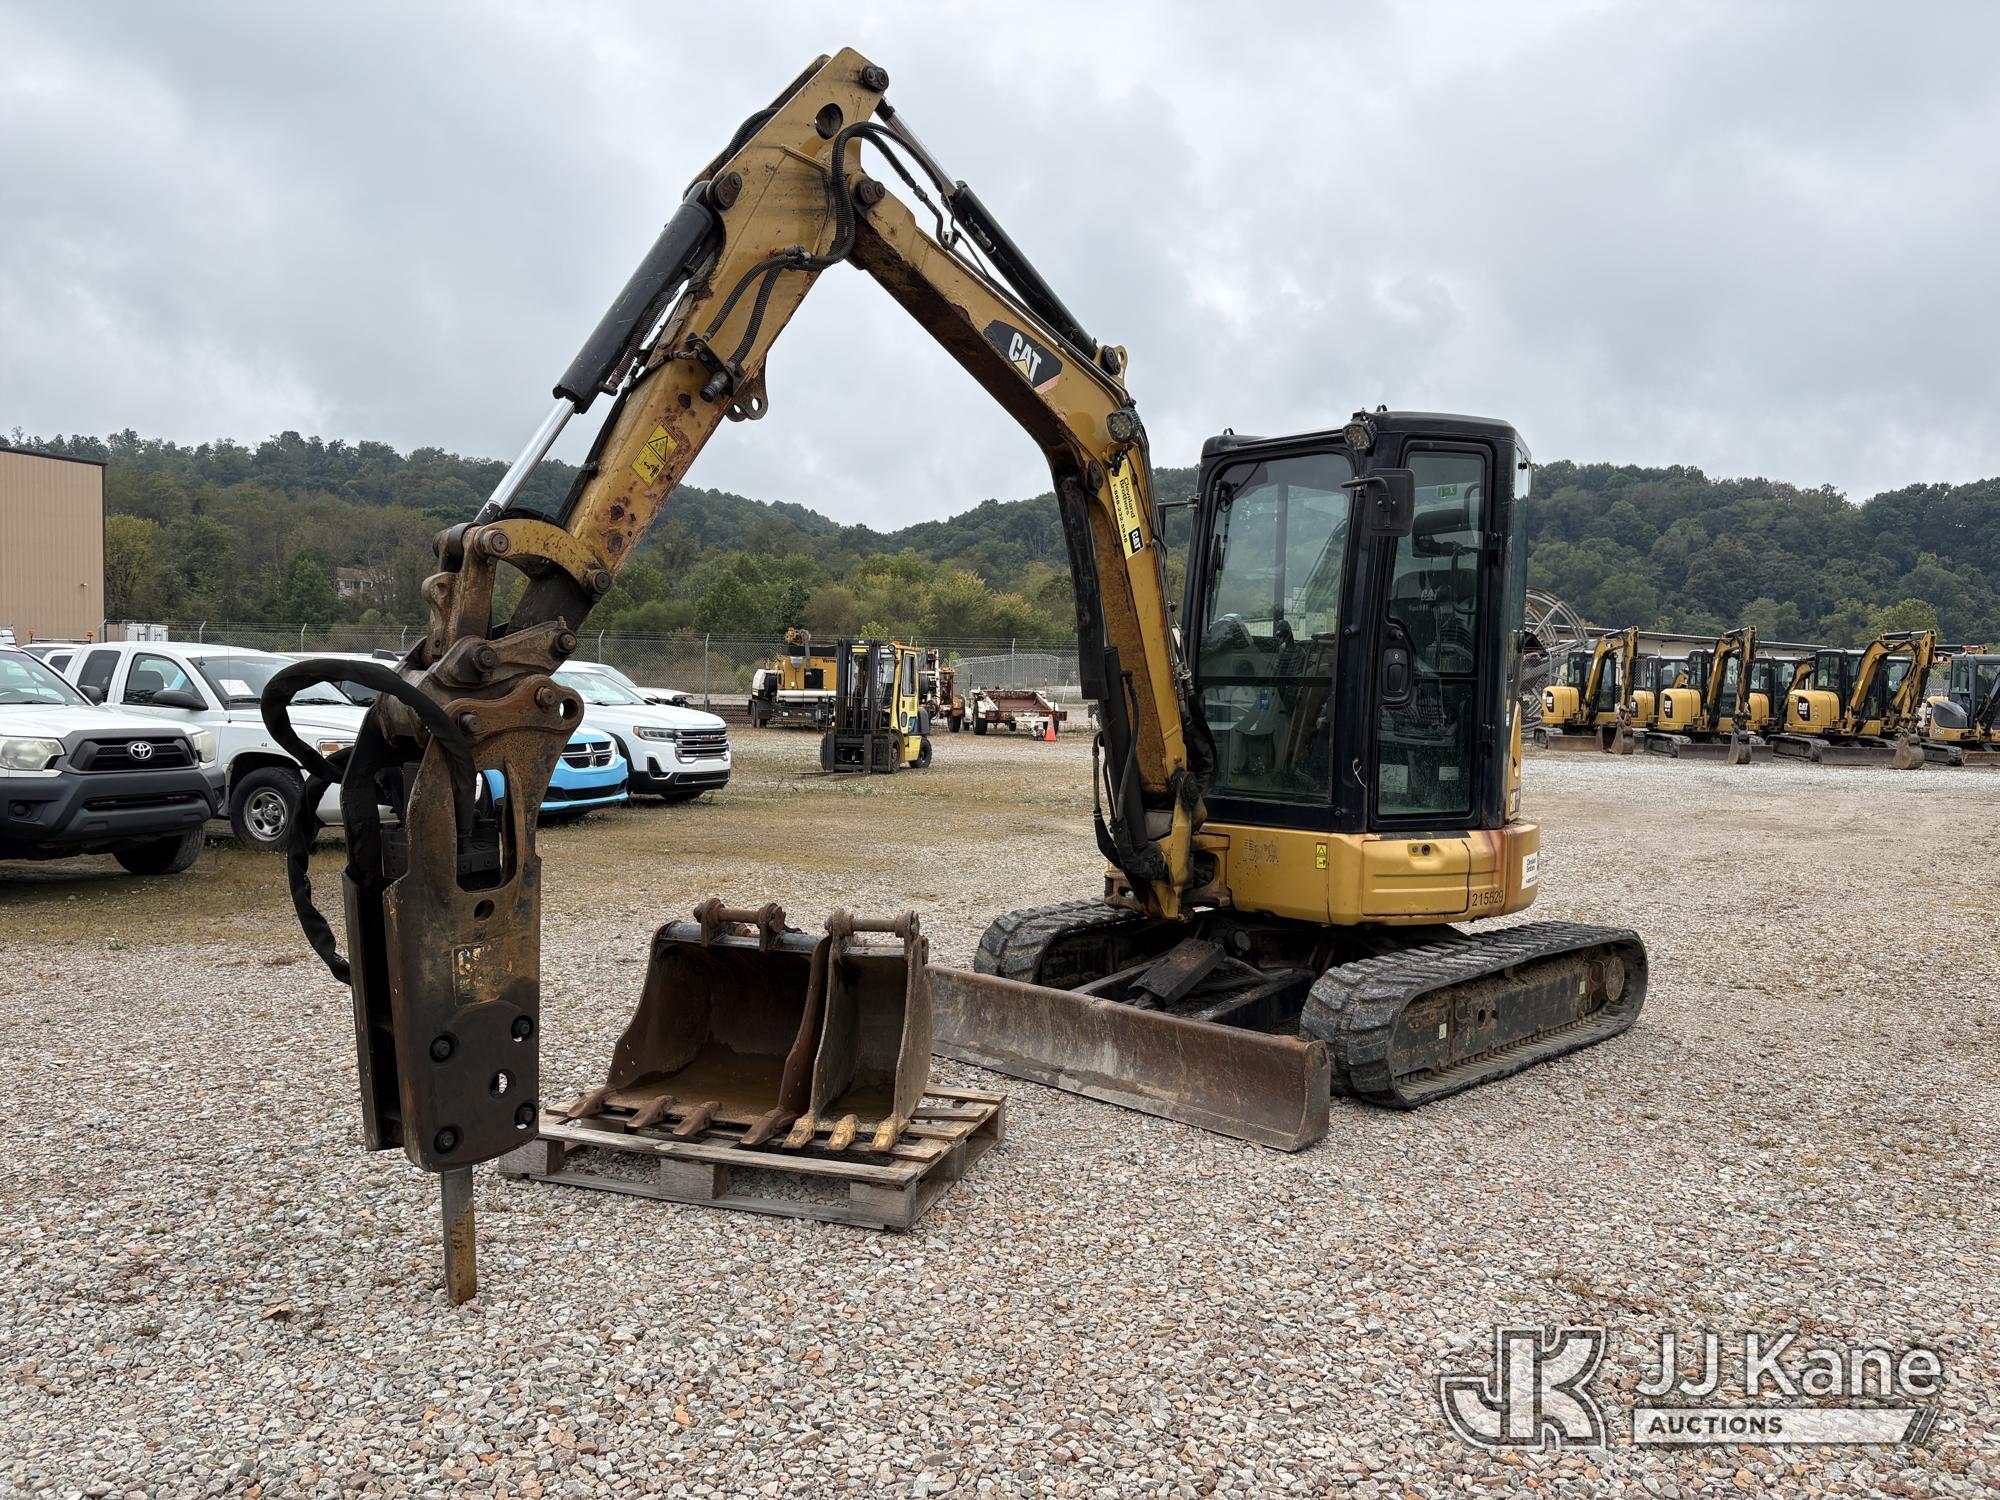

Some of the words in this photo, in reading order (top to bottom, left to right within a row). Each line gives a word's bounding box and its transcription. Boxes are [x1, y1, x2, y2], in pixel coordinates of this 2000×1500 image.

[1008, 332, 1042, 382] CAT
[1120, 479, 1130, 516] Brothers
[1124, 476, 1136, 519] Cleveland
[1131, 530, 1141, 550] CAT
